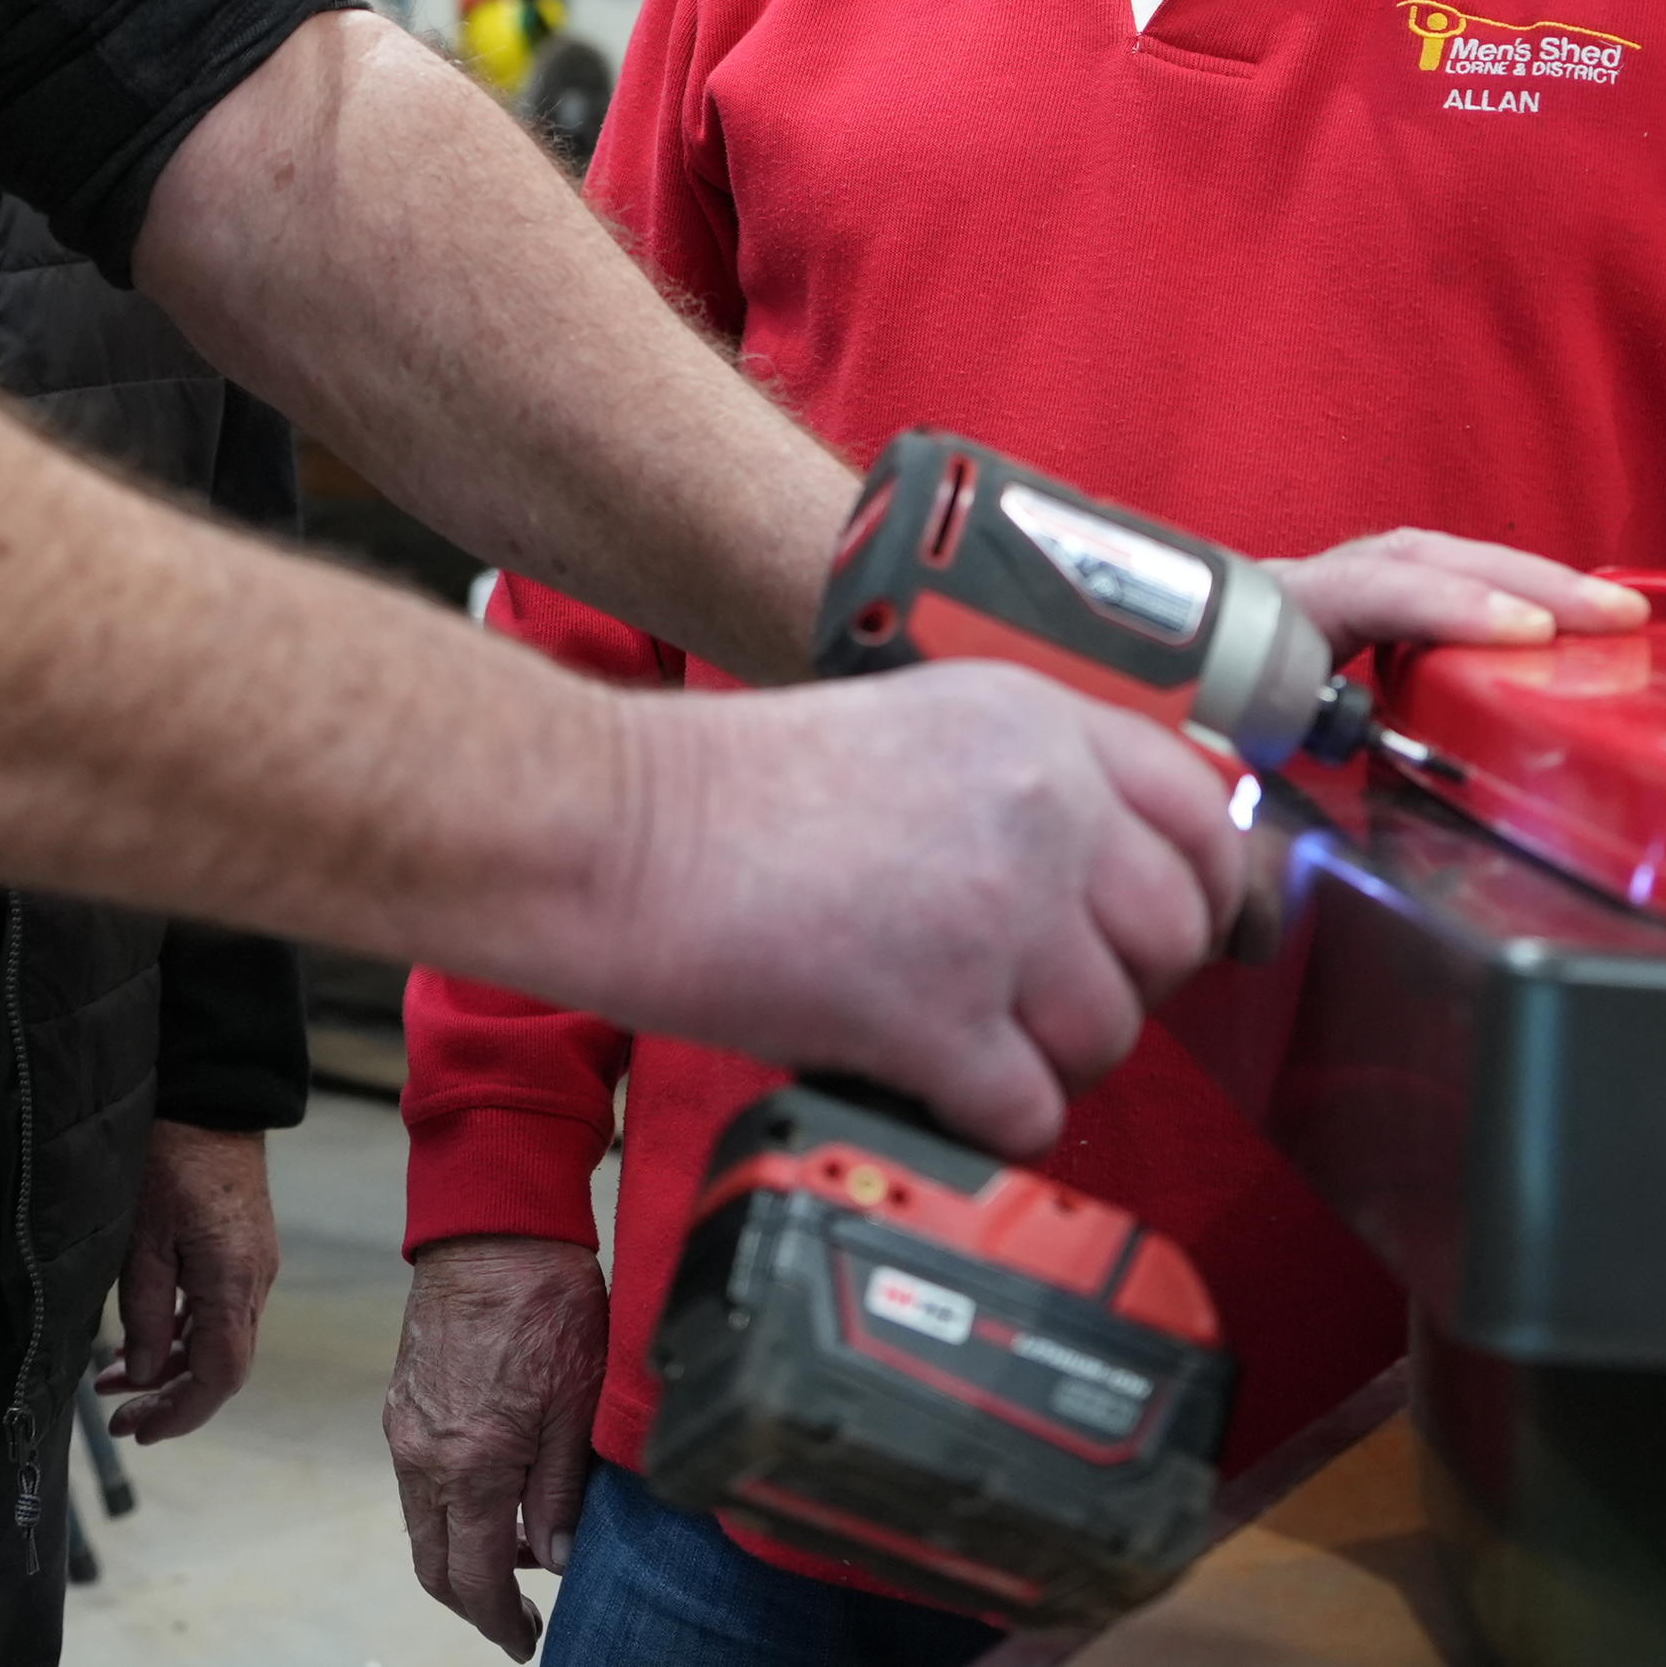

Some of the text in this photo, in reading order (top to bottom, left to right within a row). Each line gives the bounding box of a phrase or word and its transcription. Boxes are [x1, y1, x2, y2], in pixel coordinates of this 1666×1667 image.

[1449, 37, 1621, 67] Men's Shed
[1445, 61, 1620, 84] LORNE & DISTRICT
[1443, 89, 1540, 113] ALLAN
